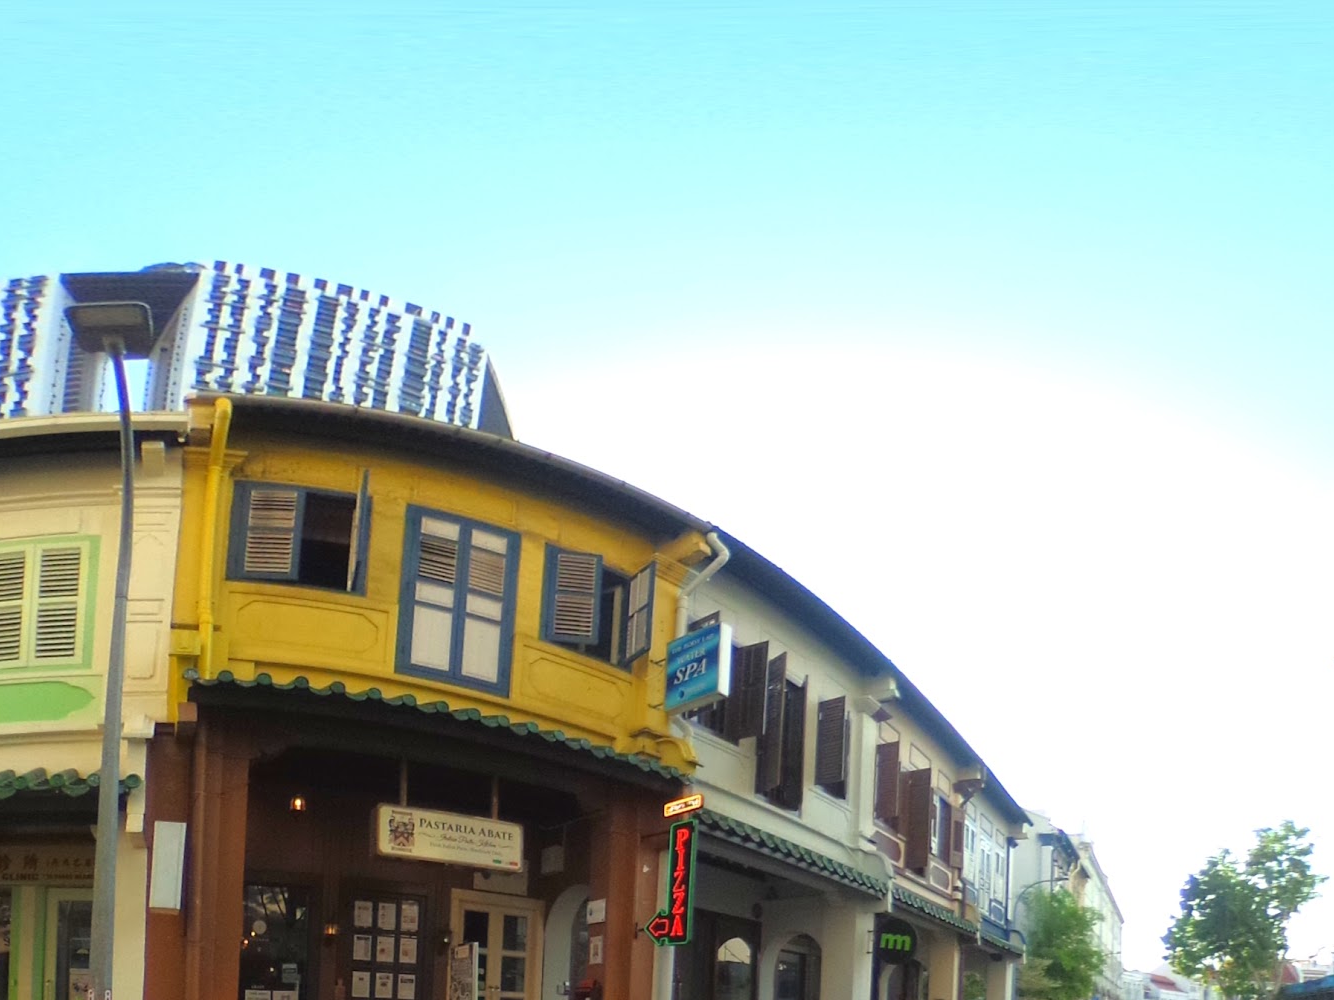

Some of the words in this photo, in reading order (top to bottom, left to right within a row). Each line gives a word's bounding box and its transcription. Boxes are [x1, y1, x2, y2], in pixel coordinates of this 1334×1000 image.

[673, 658, 706, 685] SPA
[419, 818, 476, 835] PASTARIA
[478, 827, 514, 841] ABATE
[2, 873, 39, 881] CLINIC
[670, 829, 689, 936] PIZZA
